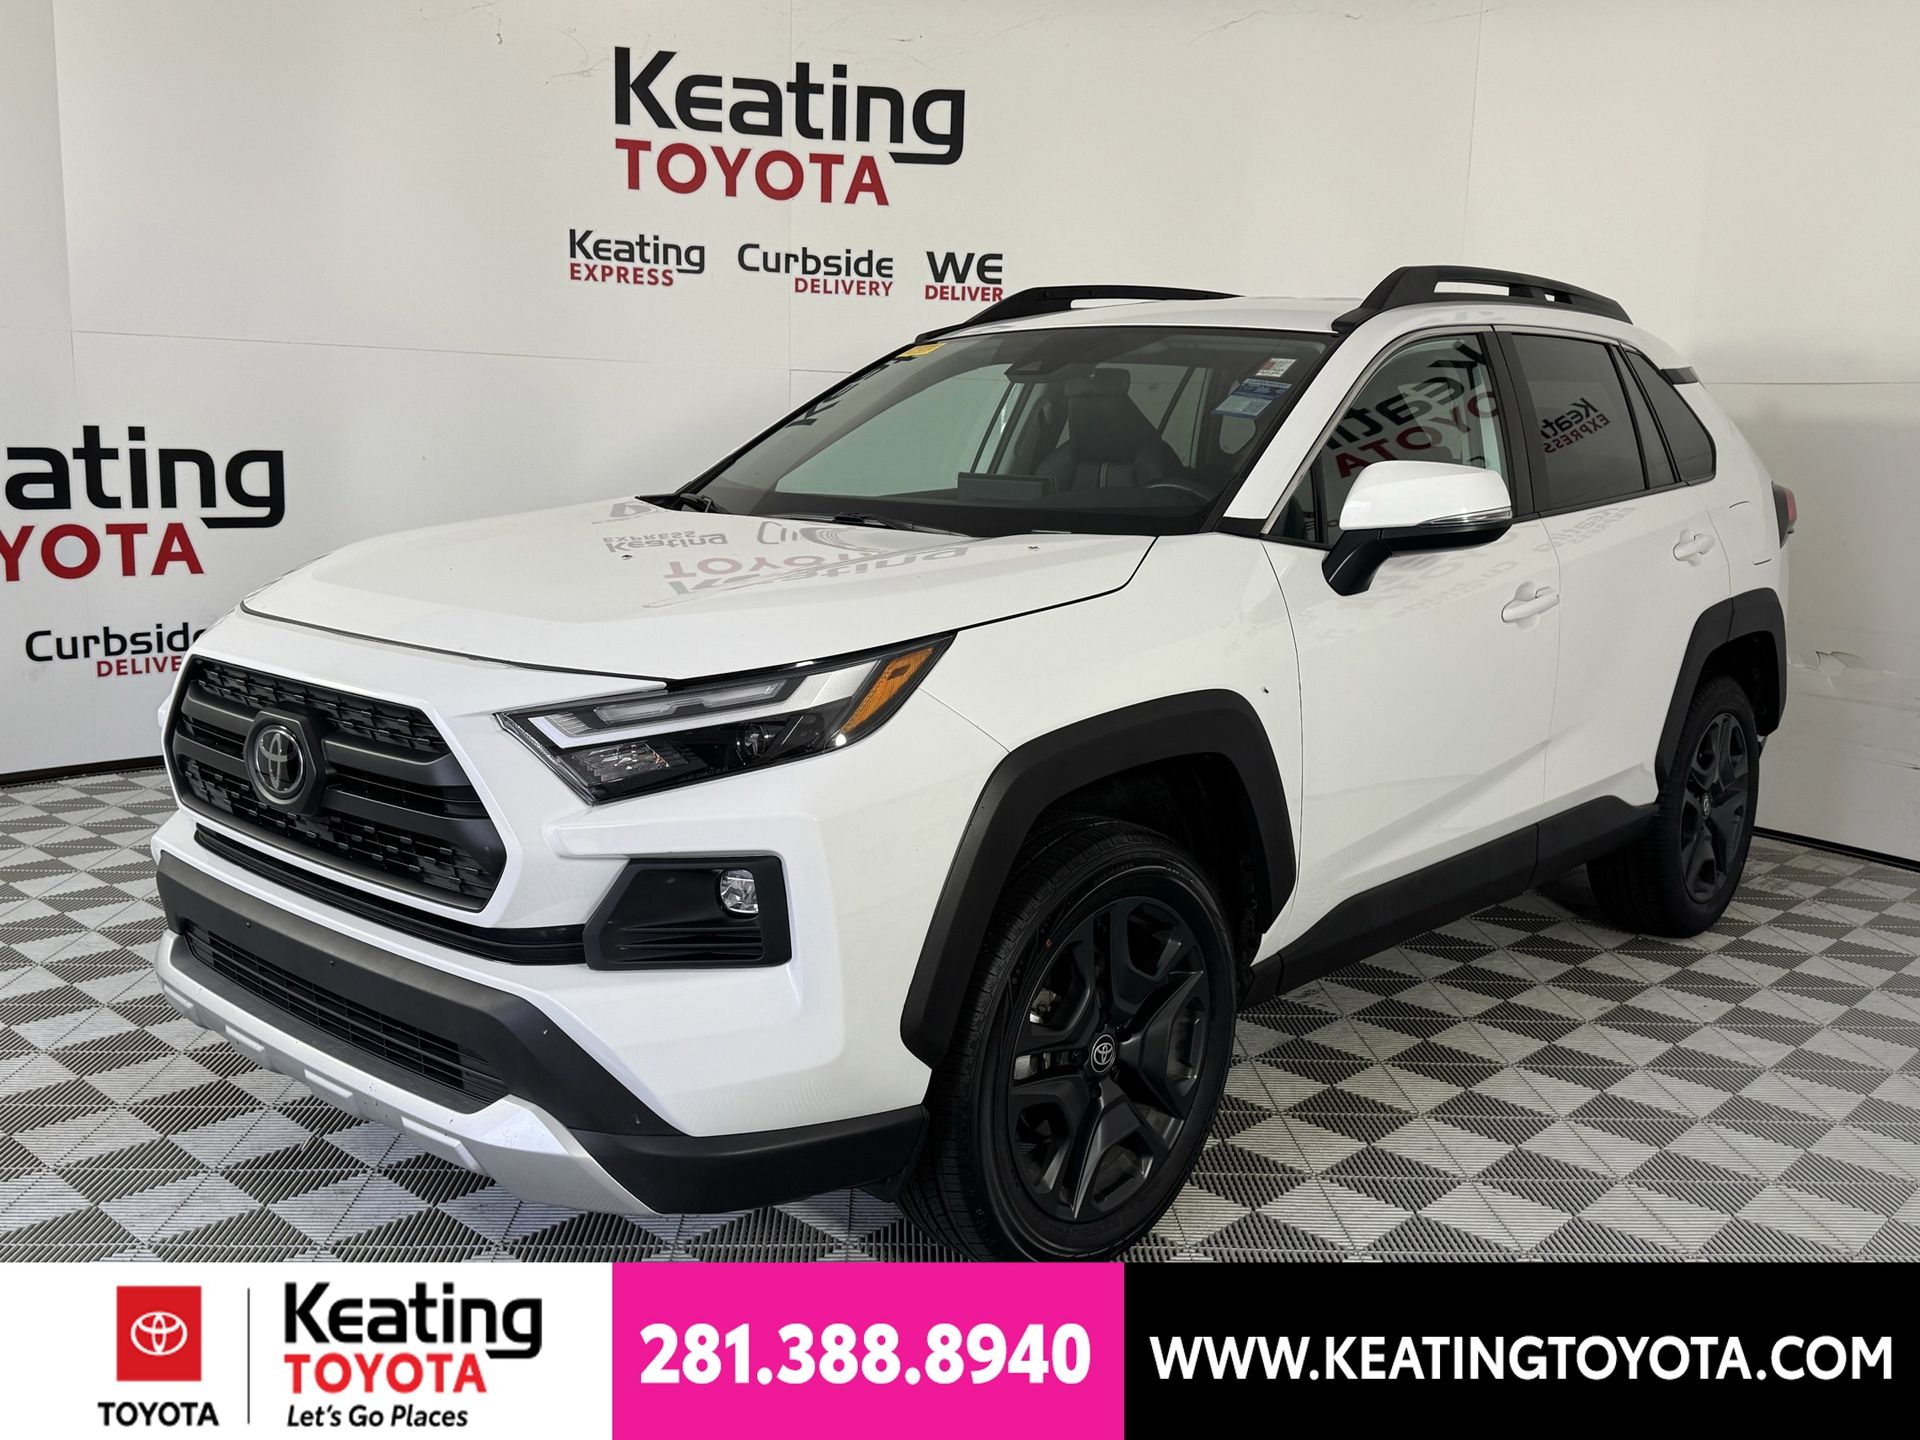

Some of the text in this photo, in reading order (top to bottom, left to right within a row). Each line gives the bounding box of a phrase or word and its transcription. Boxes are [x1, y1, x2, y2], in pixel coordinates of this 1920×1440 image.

[614, 46, 966, 166] Keating
[615, 138, 890, 206] TOYOTA
[569, 228, 705, 275] Keating
[738, 243, 894, 279] Curbside
[926, 251, 1003, 285] WE
[570, 263, 674, 287] EXPRESS
[794, 277, 894, 297] DELIVERY
[925, 285, 1004, 302] DELIVER
[4, 425, 286, 529] ating
[0, 522, 205, 582] YOTA
[26, 621, 207, 662] Curbsid
